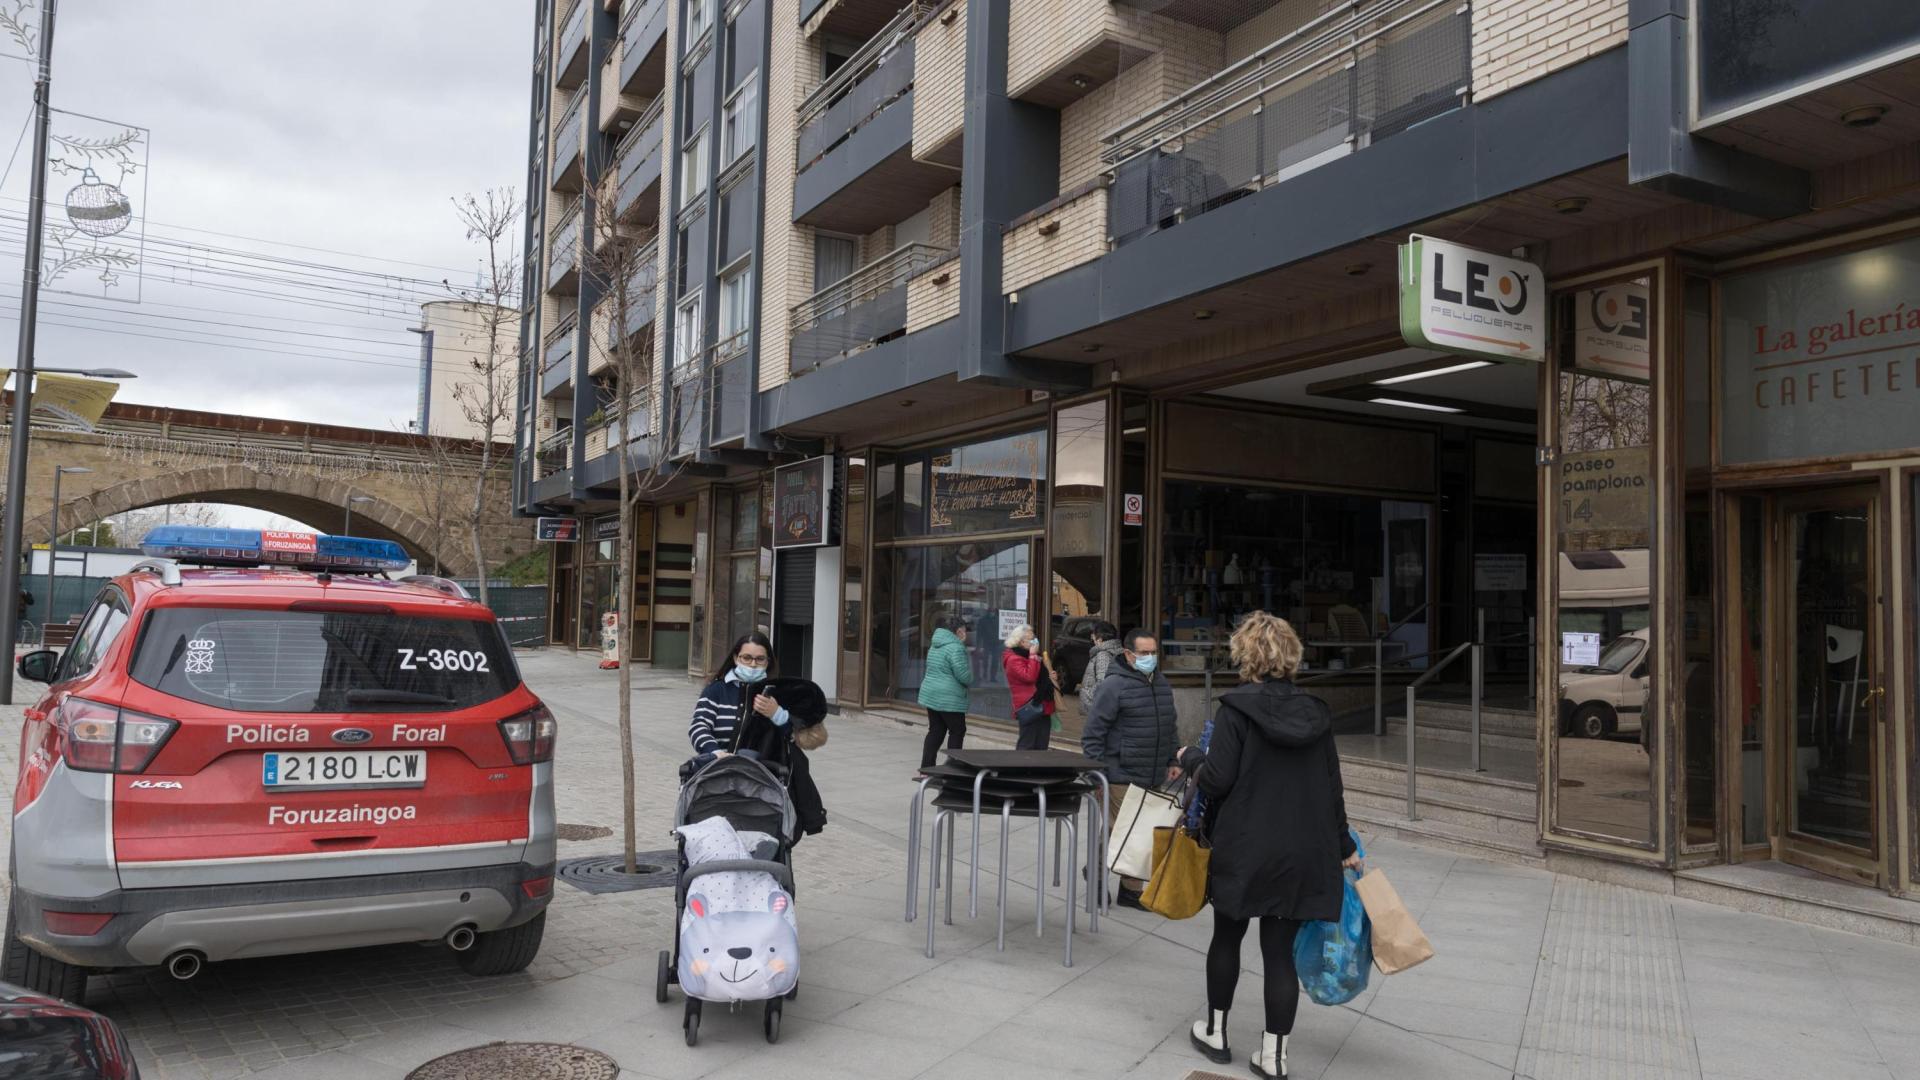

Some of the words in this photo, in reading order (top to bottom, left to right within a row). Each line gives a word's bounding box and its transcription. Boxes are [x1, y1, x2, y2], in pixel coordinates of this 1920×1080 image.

[1434, 252, 1528, 315] LEO
[1431, 306, 1533, 332] PELUQUERIA
[1754, 324, 1797, 355] La
[1807, 302, 1920, 355] galería
[1563, 459, 1615, 476] paseo
[1563, 474, 1645, 495] pamplona
[999, 487, 1029, 506] HOBBY
[1562, 498, 1593, 524] 14
[268, 540, 311, 550] FORUZAINGOA
[398, 649, 490, 673] Z-3602
[226, 724, 310, 743] Policía
[340, 731, 365, 742] Ford
[392, 724, 447, 742] Foral
[268, 772, 274, 780] E
[284, 755, 357, 781] 2180
[368, 754, 420, 779] LCW
[129, 780, 183, 789] KUGA
[268, 805, 416, 826] Foruzaingoa
